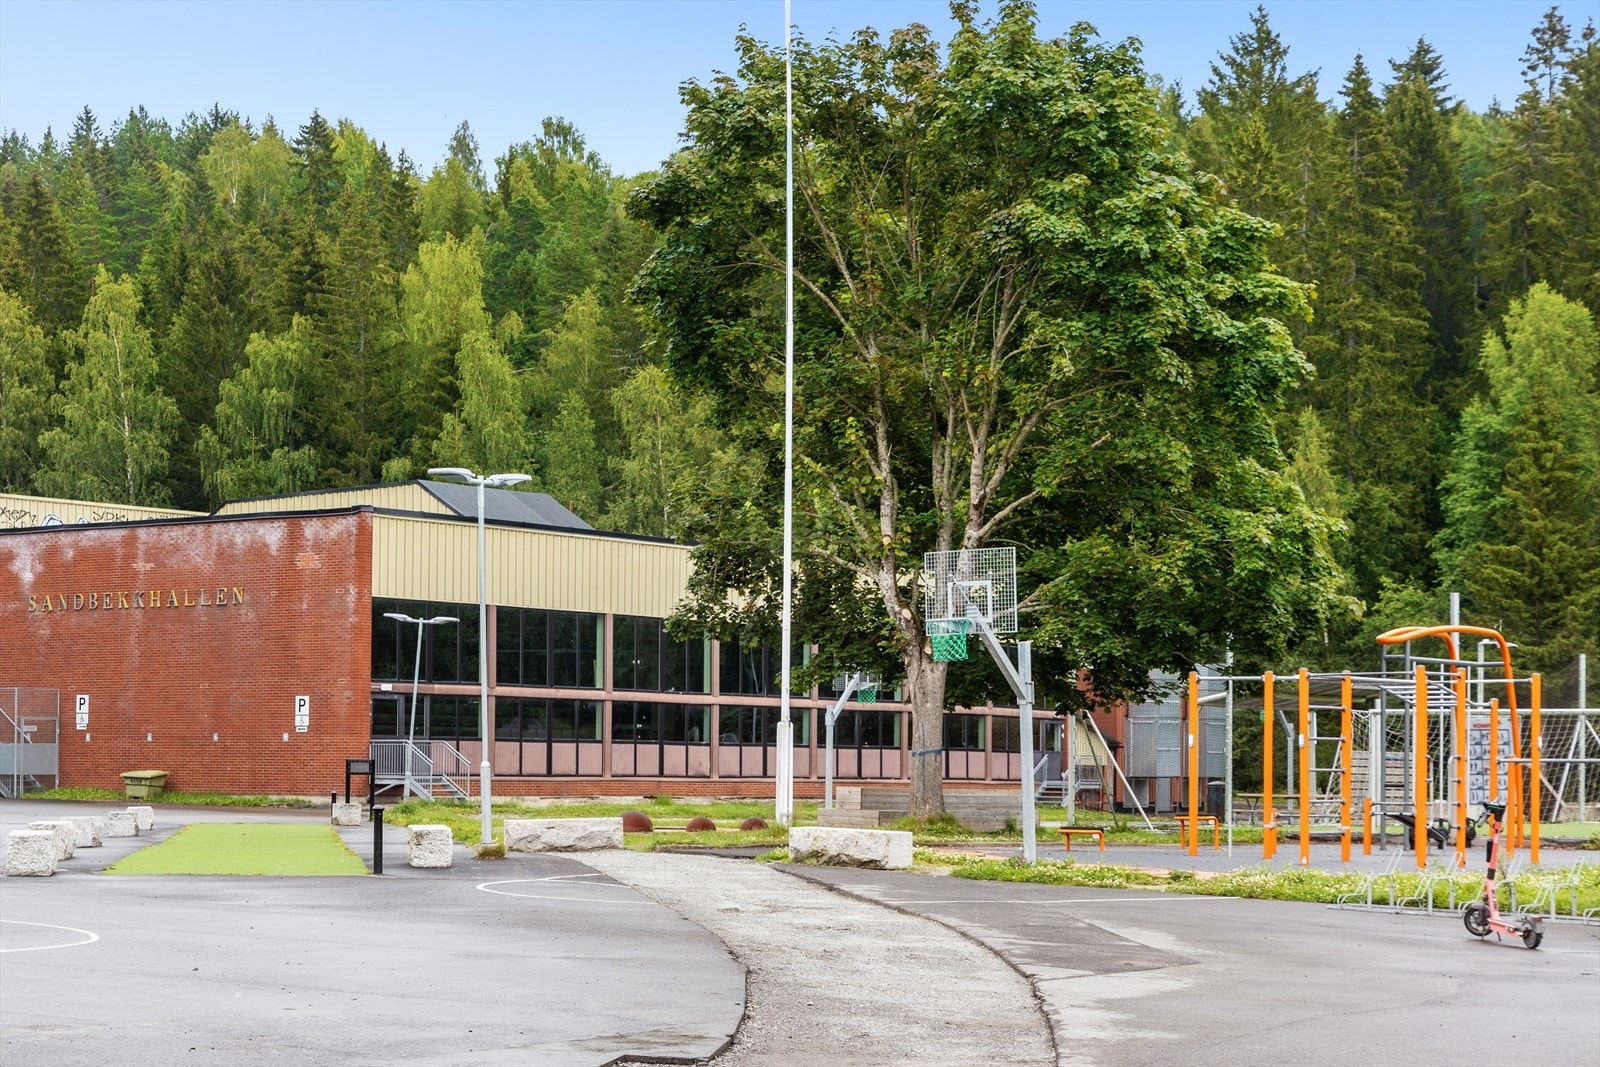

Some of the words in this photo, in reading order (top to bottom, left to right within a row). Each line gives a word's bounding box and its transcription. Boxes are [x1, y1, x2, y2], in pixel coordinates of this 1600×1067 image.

[28, 587, 244, 612] SANDBEKKHALLEN
[79, 697, 86, 711] P
[298, 698, 306, 712] P
